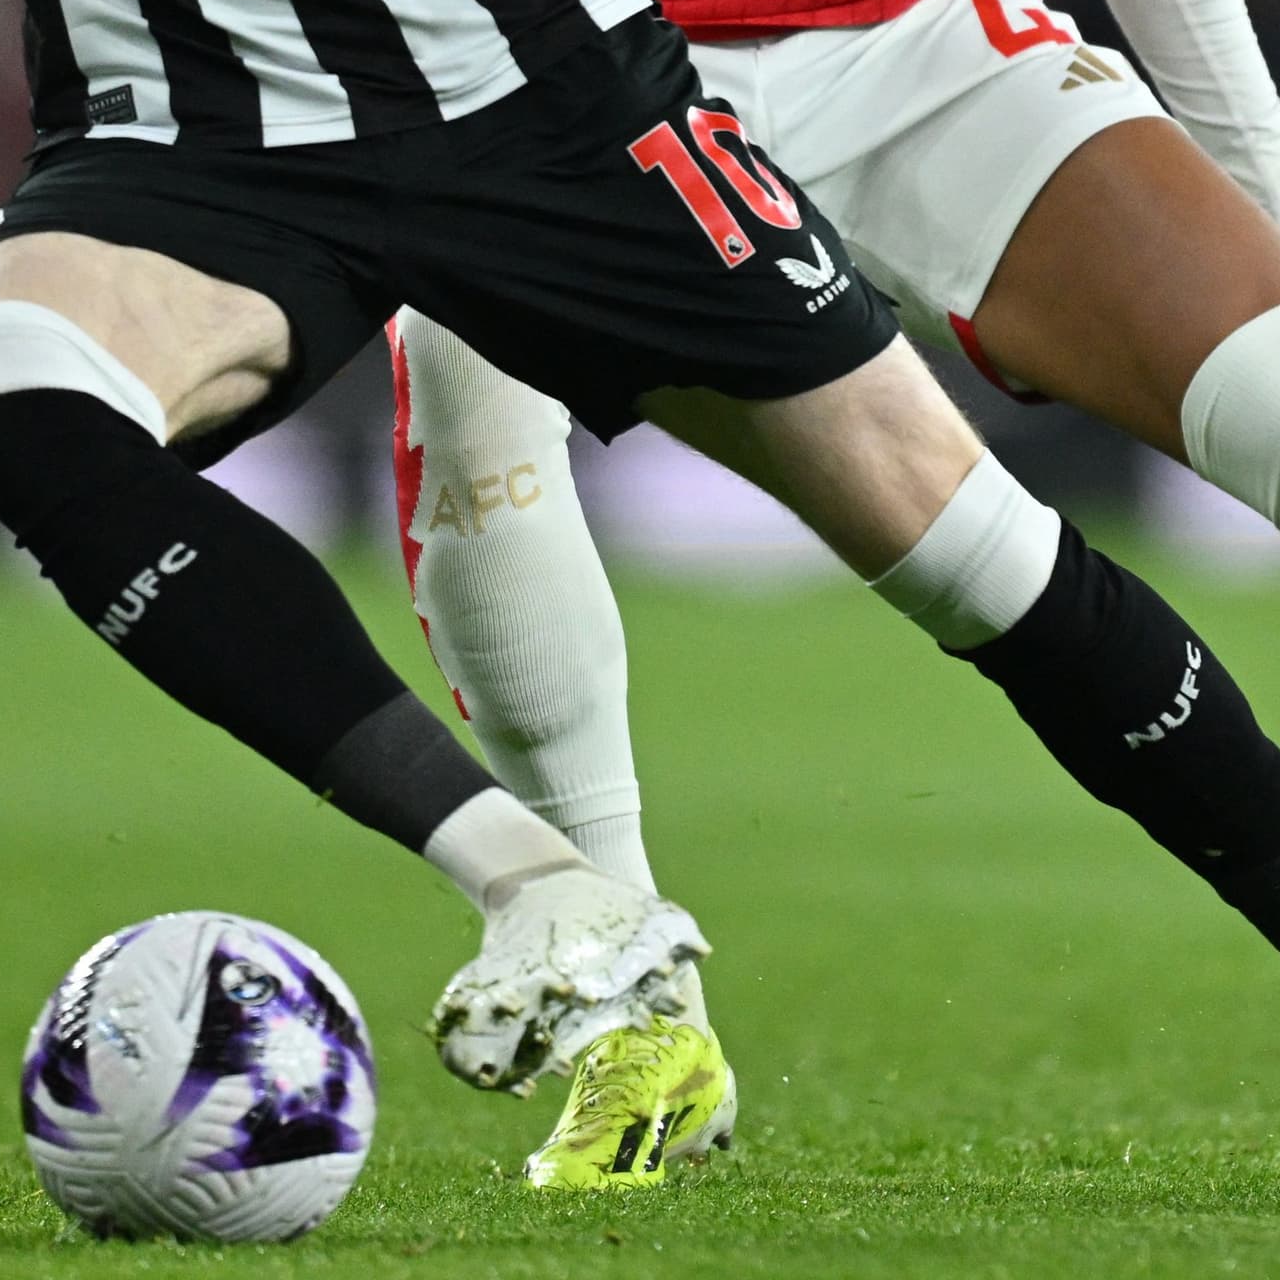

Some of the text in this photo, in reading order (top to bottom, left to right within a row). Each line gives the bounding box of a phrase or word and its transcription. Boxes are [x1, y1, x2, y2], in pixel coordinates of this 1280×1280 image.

[625, 105, 803, 270] 10
[428, 462, 542, 538] AFC
[96, 540, 199, 645] NUFC
[1123, 639, 1202, 751] NUFC
